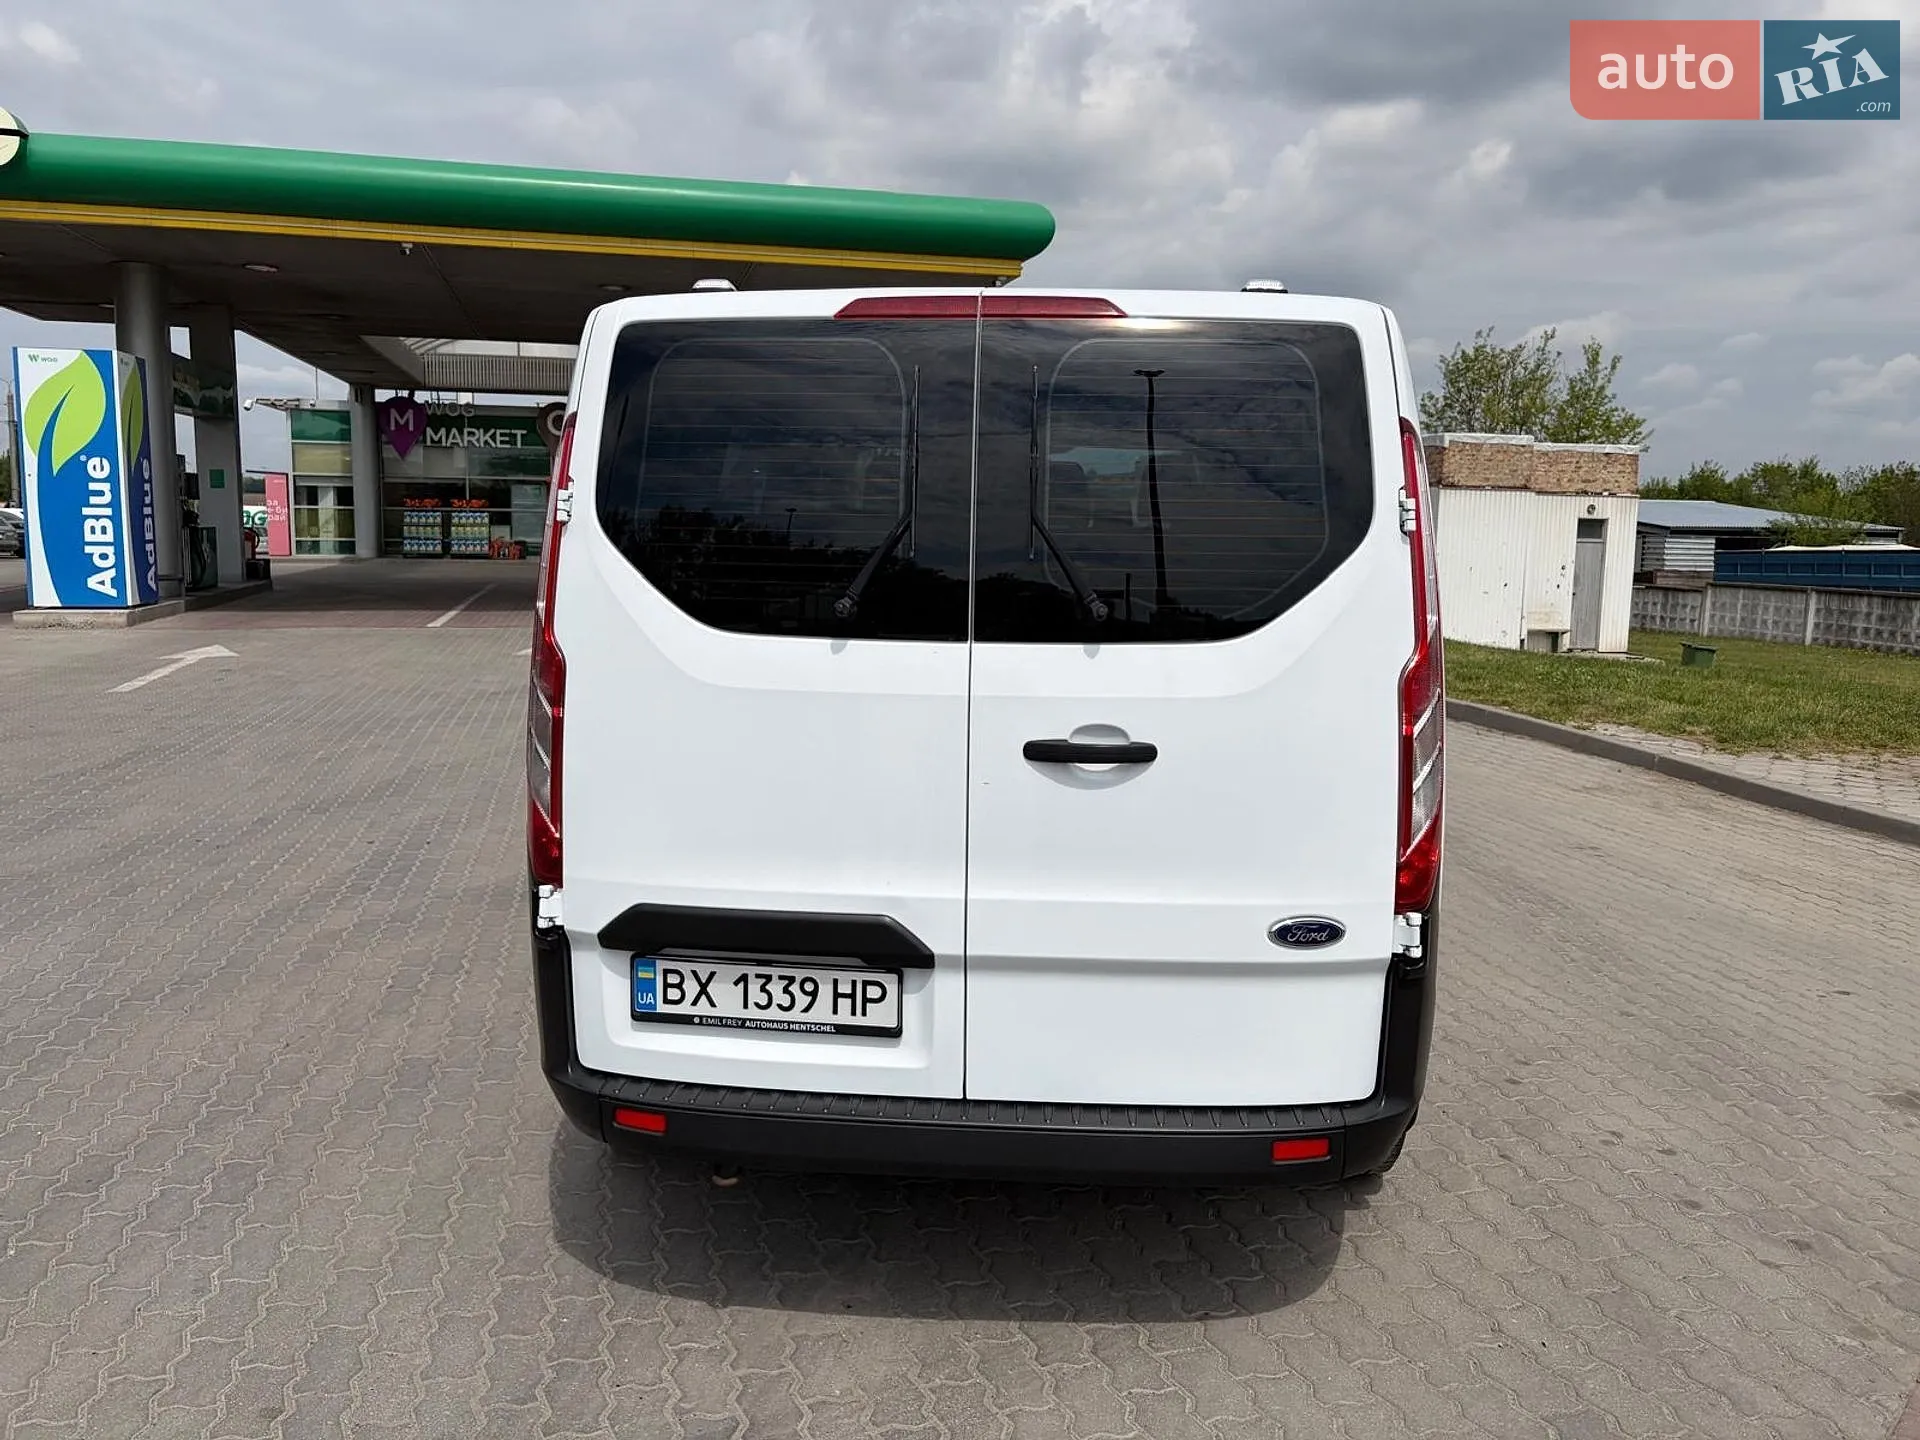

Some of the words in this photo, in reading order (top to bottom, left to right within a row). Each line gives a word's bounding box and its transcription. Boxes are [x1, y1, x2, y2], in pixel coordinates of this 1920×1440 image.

[424, 402, 475, 417] WOG
[390, 408, 413, 432] M
[426, 427, 527, 448] MARKET
[1287, 925, 1330, 942] Ford
[638, 992, 655, 1005] UA
[662, 968, 717, 1008] BX
[732, 973, 820, 1014] 1339
[832, 977, 888, 1018] HP
[702, 1017, 722, 1026] EMIL
[722, 1018, 743, 1027] FREY
[745, 1020, 788, 1031] AUTOHAUS
[790, 1022, 837, 1033] HENTSCHEL
